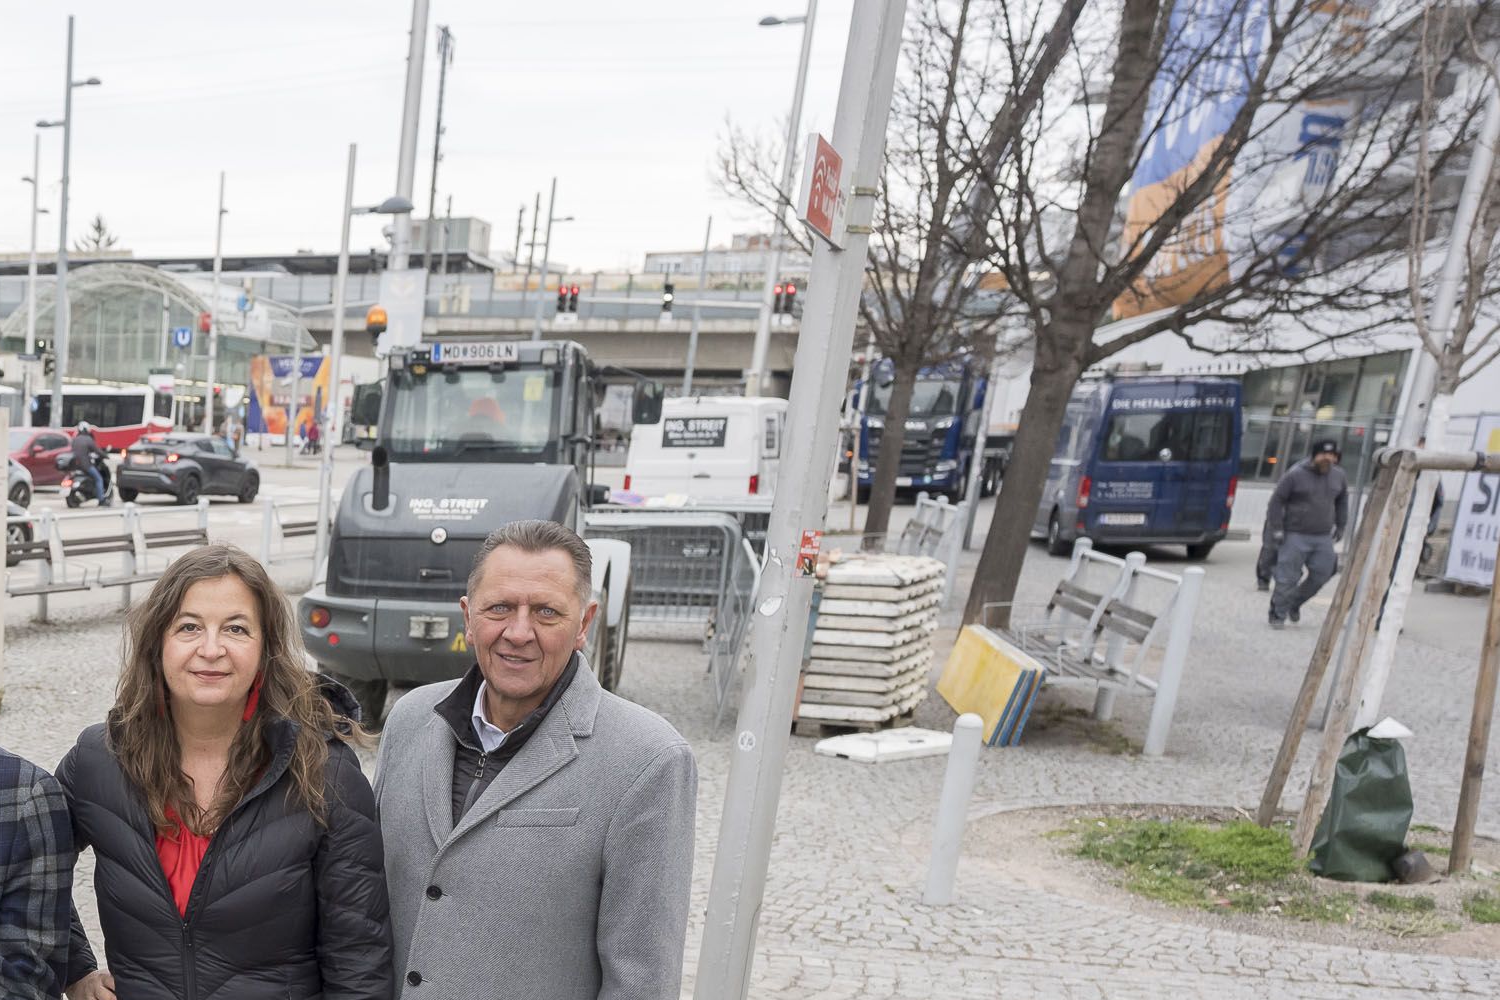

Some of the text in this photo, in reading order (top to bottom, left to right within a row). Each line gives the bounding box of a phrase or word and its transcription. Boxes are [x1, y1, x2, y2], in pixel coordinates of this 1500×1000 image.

[177, 331, 191, 346] U
[1112, 397, 1129, 410] DIE
[687, 418, 726, 431] STREIT
[409, 498, 489, 508] ING. STREIT
